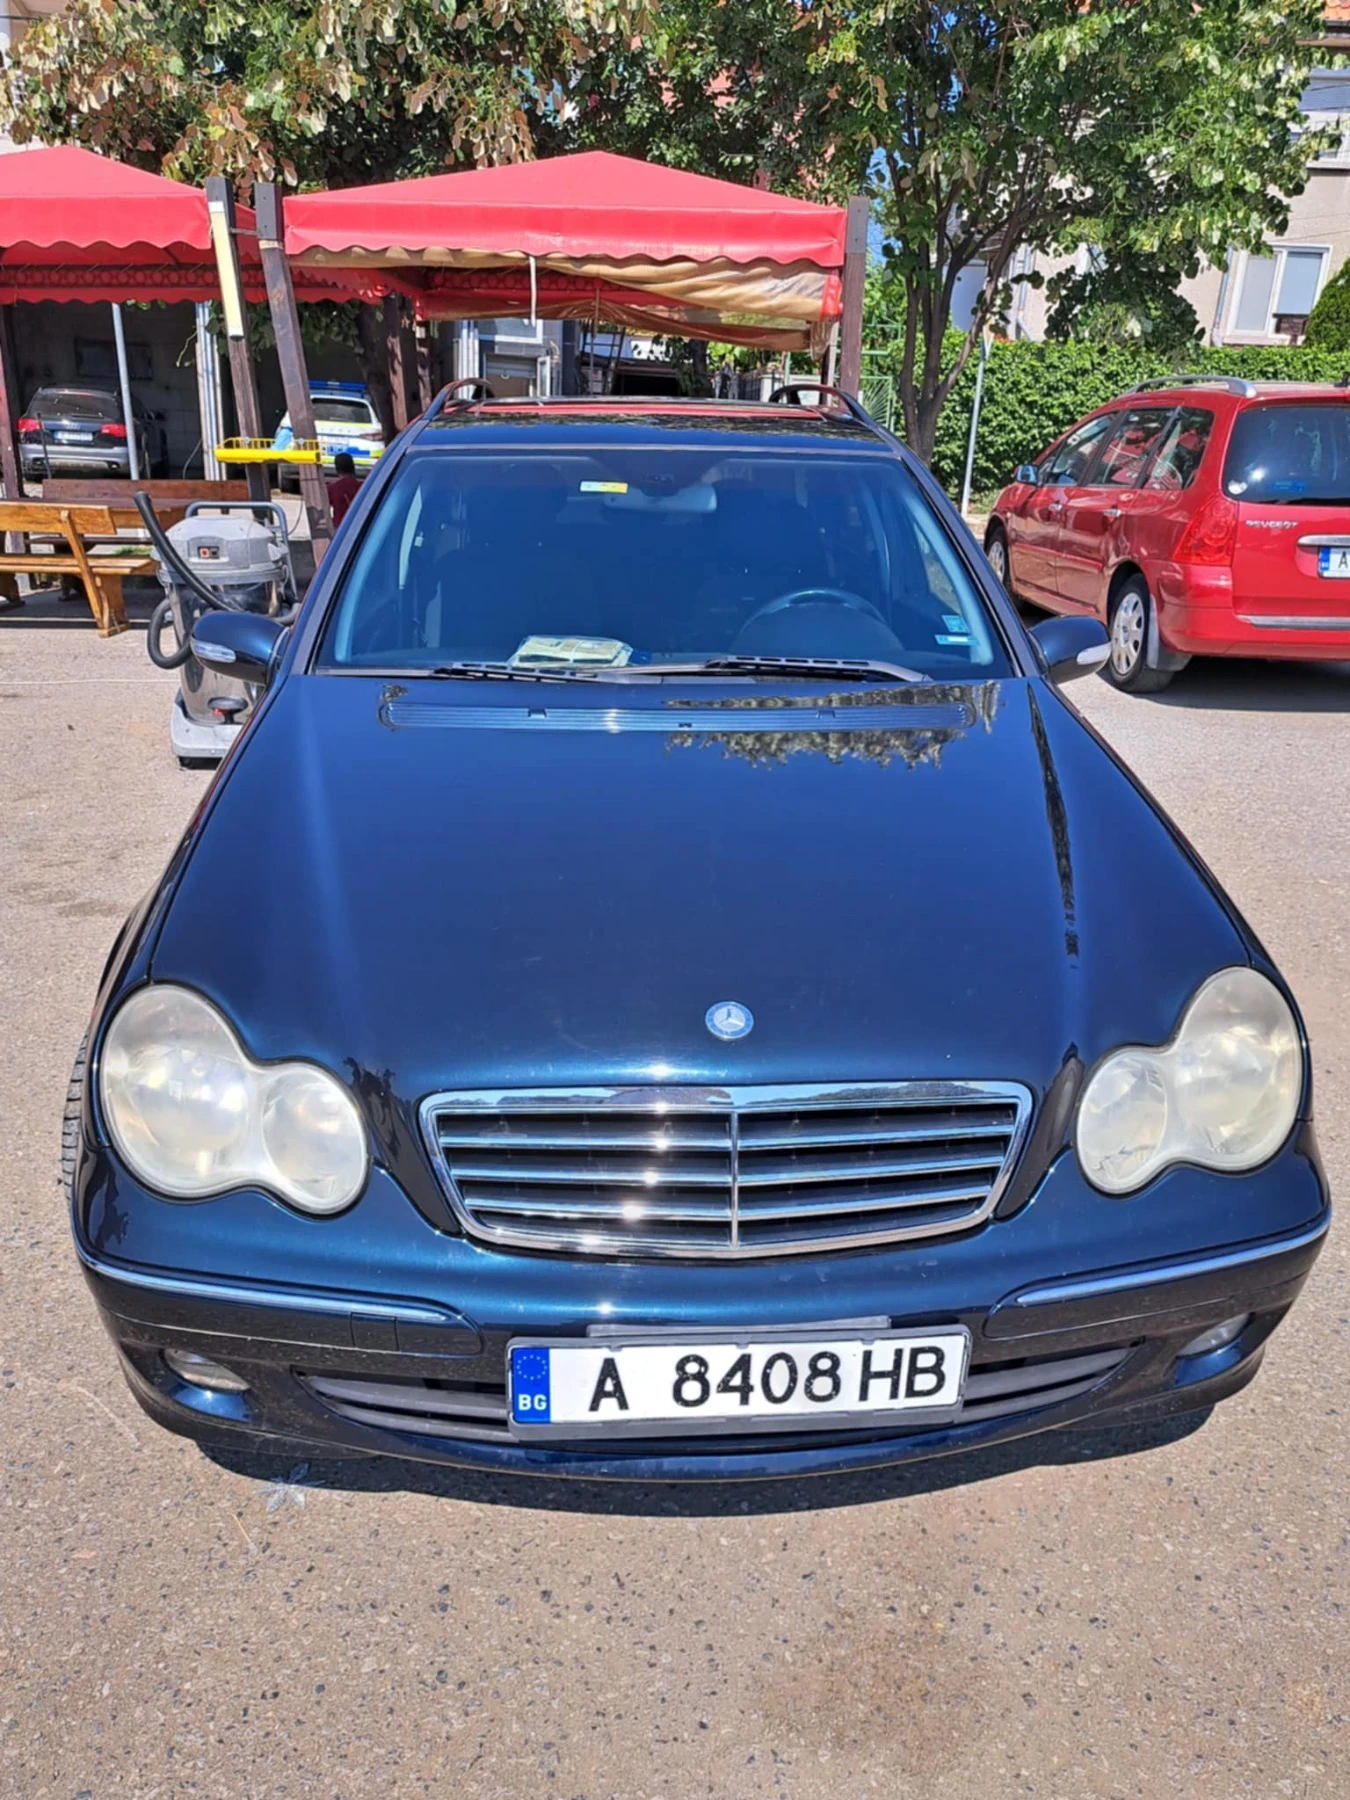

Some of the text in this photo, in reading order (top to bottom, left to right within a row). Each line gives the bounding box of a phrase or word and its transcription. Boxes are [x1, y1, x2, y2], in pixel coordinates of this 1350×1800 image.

[1338, 551, 1348, 569] A
[588, 1346, 946, 1412] A 8408 HB
[518, 1393, 547, 1411] BG
